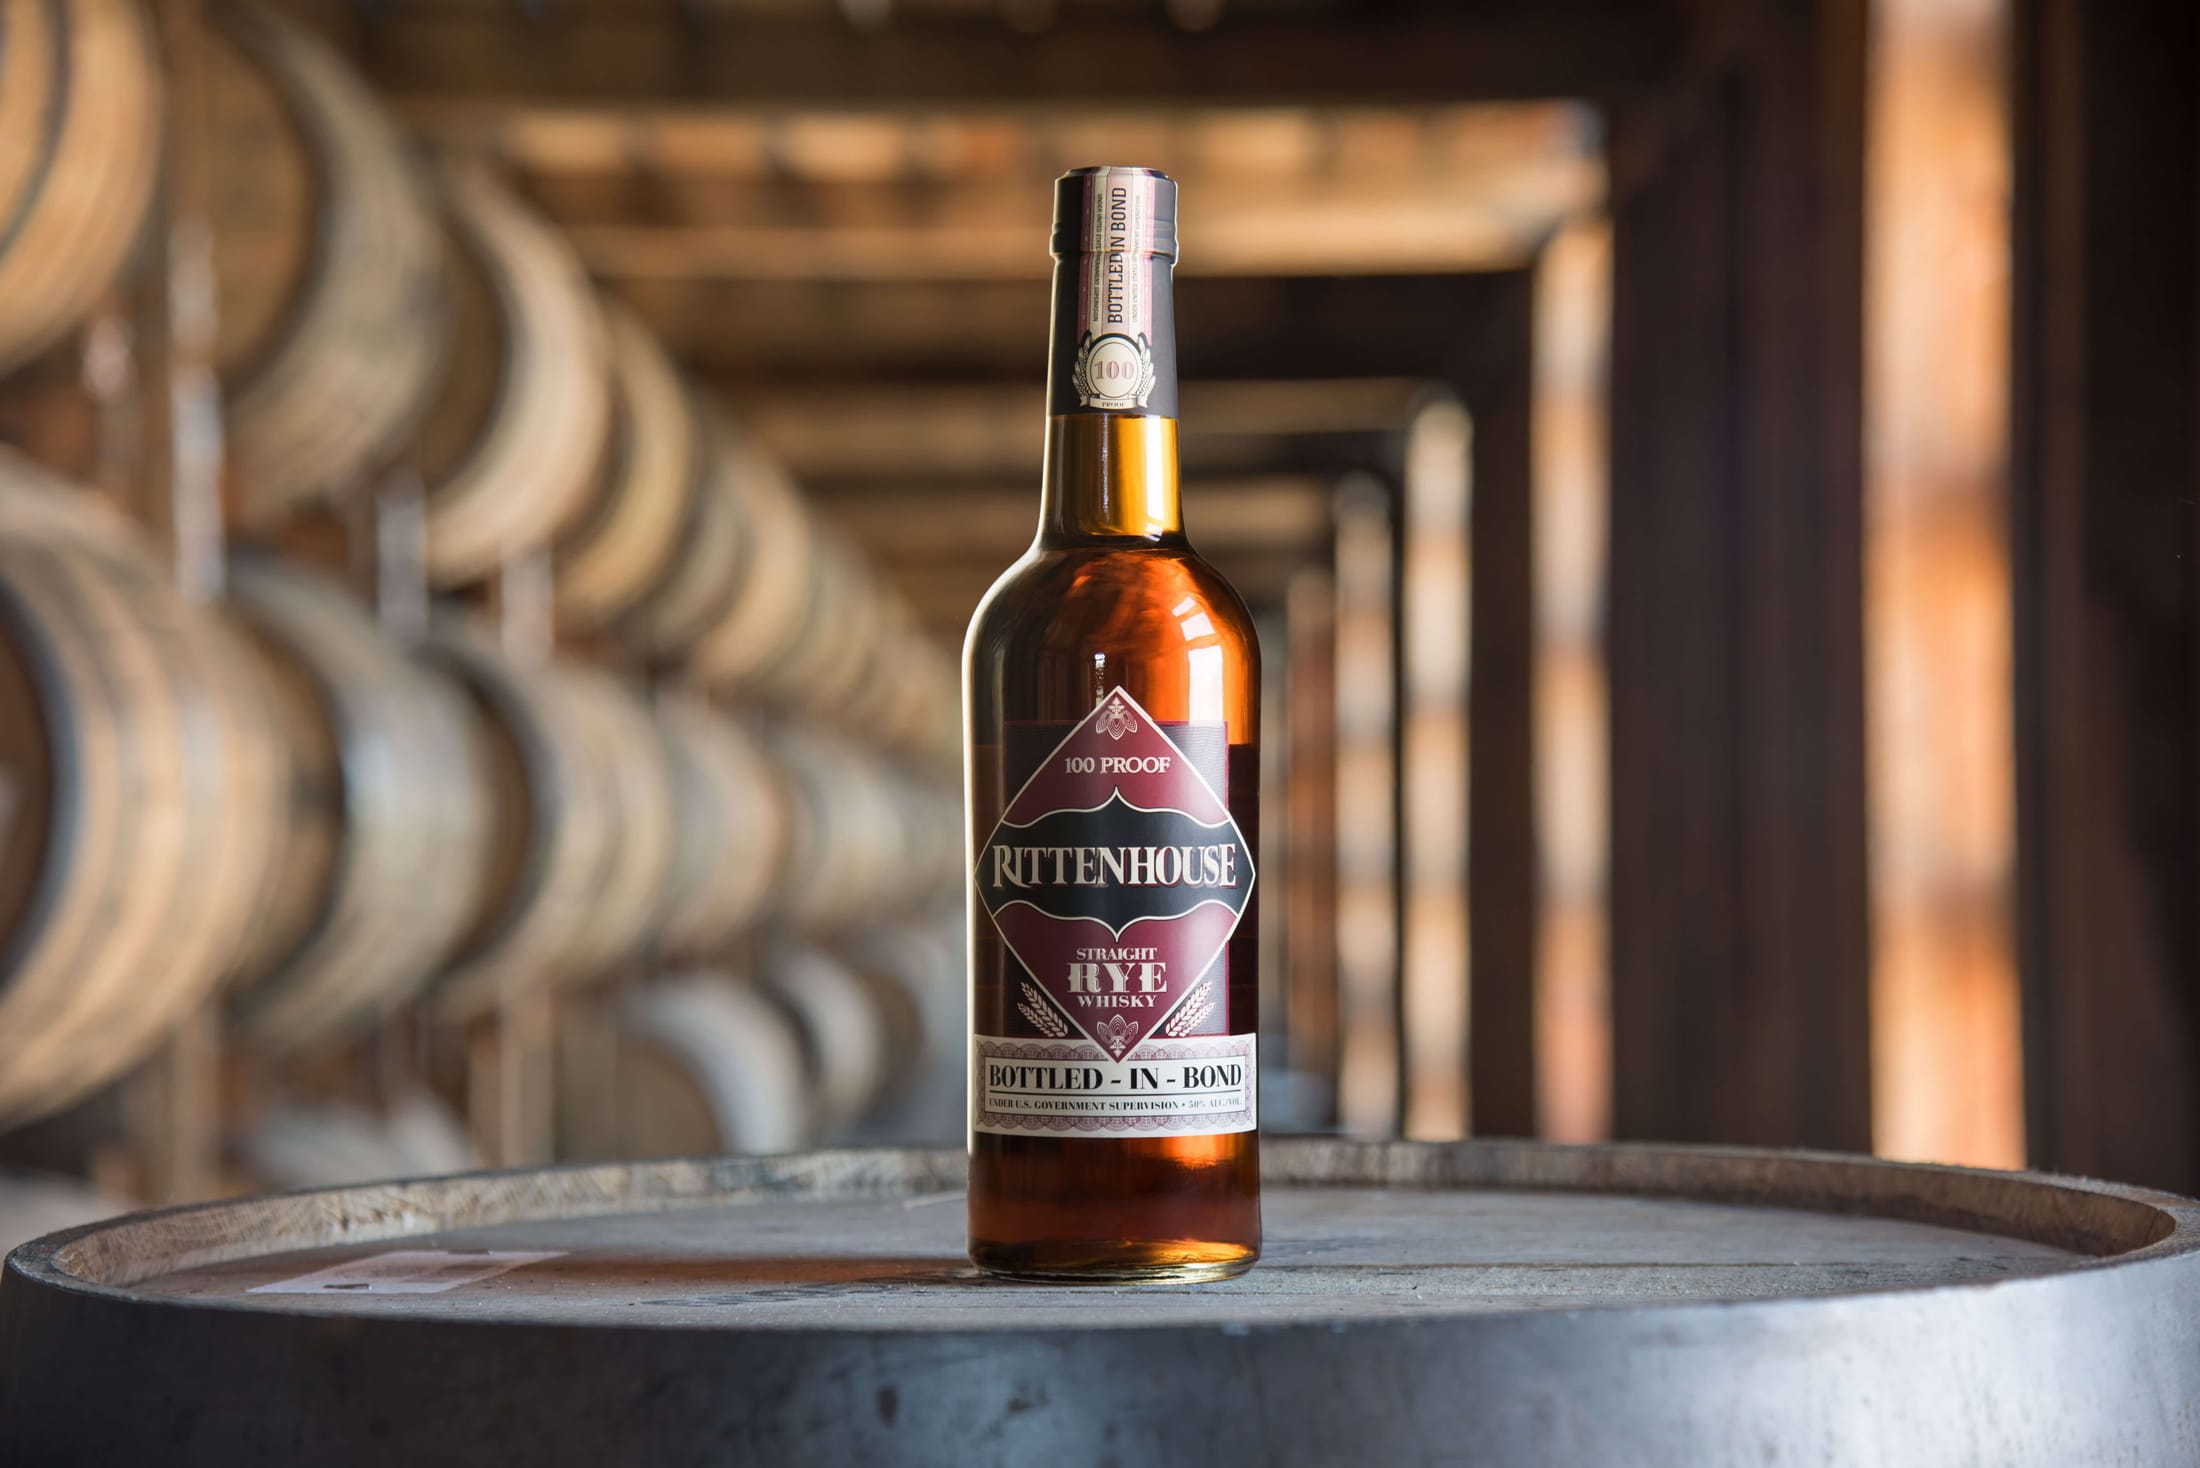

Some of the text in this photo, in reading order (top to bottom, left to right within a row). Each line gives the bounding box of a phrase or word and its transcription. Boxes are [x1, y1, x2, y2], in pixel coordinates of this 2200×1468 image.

[1108, 187, 1127, 323] BOTTLED IN BOND
[1094, 360, 1134, 379] 100
[1064, 757, 1171, 773] 100 PROOF
[992, 843, 1239, 889] RITTENHOUSE
[1076, 947, 1157, 961] STRAIGHT
[1066, 962, 1168, 993] RYE
[1077, 995, 1157, 1008] WHISKY
[989, 1064, 1104, 1090] BOTTLED
[1129, 1067, 1159, 1090] IN
[1182, 1064, 1242, 1089] BOND
[989, 1098, 1014, 1109] UNDER
[1015, 1099, 1032, 1109] U.S.
[1034, 1100, 1106, 1111] GOVERNMENT
[1108, 1101, 1179, 1111] SUPERVISION
